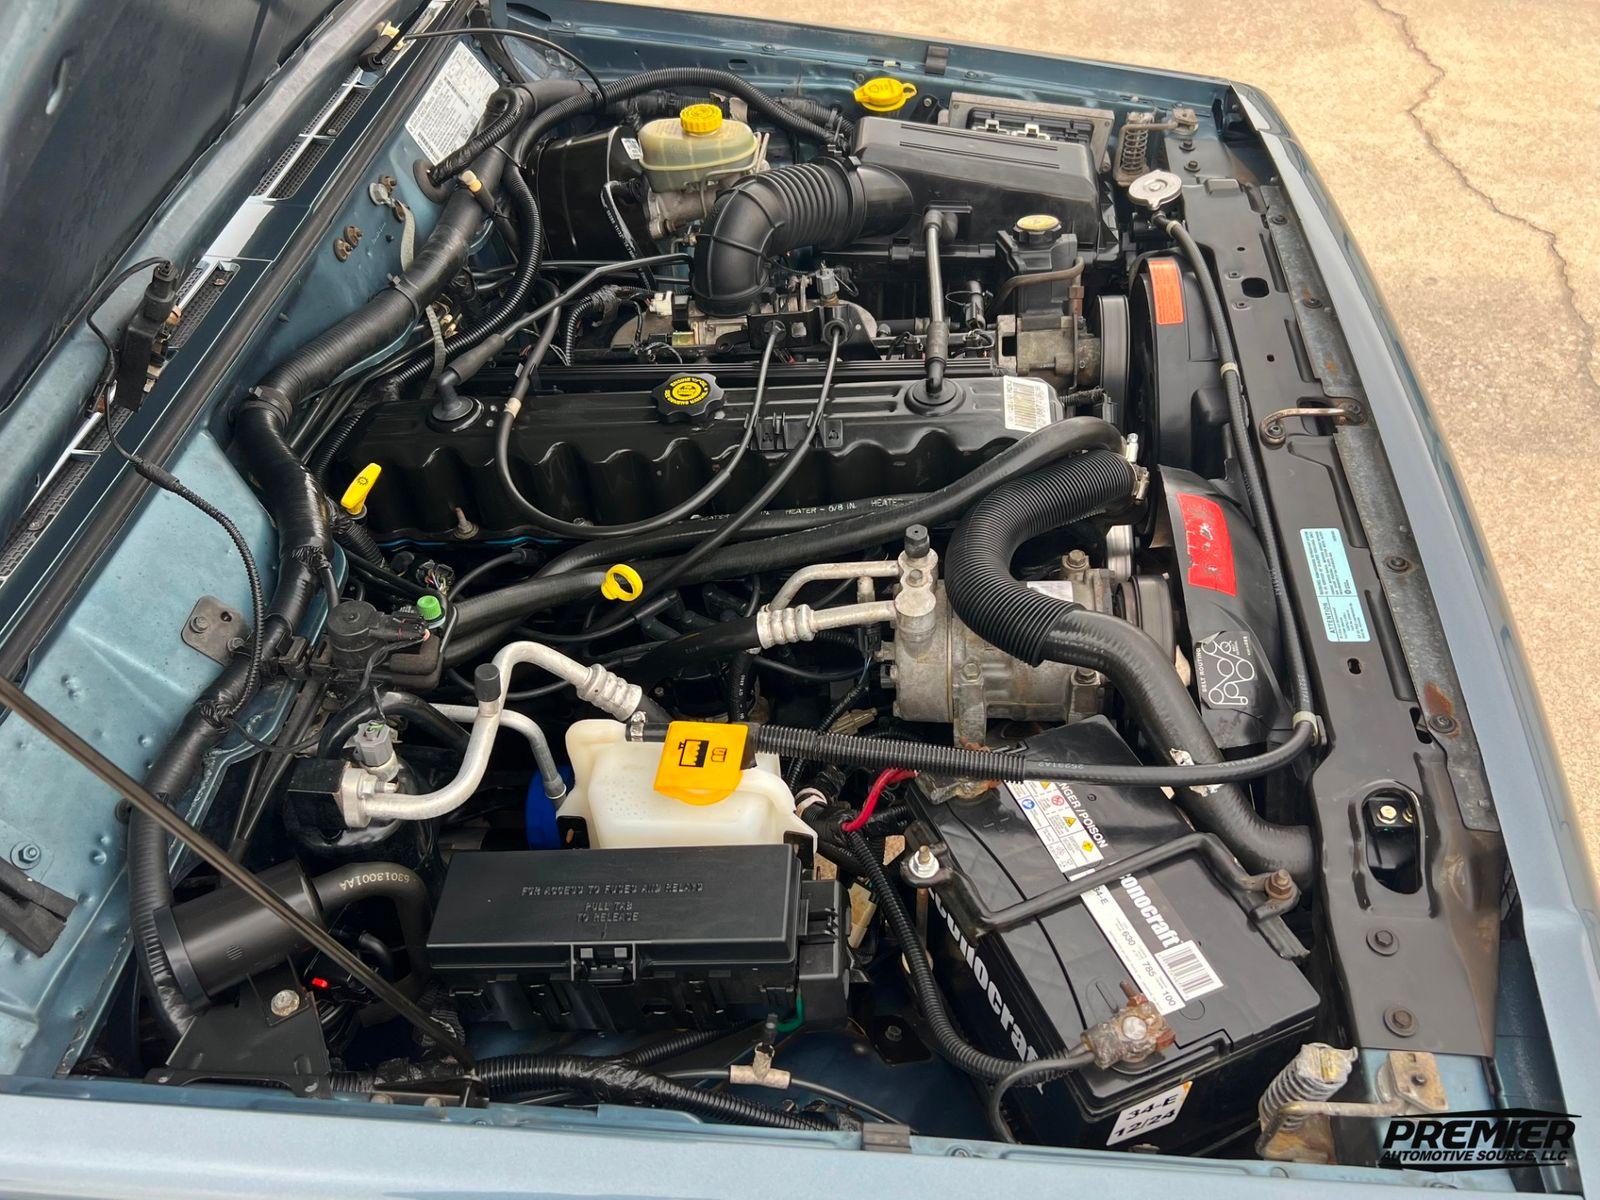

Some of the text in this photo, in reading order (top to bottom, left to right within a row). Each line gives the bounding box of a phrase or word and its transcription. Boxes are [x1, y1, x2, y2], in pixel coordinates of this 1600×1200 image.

[785, 506, 817, 516] HEATER
[1196, 647, 1205, 676] ROUTING
[1055, 782, 1081, 808] NGER
[588, 884, 601, 895] TO
[584, 901, 633, 912] PULL TAB
[1119, 873, 1180, 949] onocraft
[577, 911, 640, 923] TO RELEASE
[1141, 961, 1157, 977] 785
[1162, 990, 1176, 1007] 100
[1126, 1093, 1179, 1121] 34-E
[1114, 1109, 1176, 1137] 12/24
